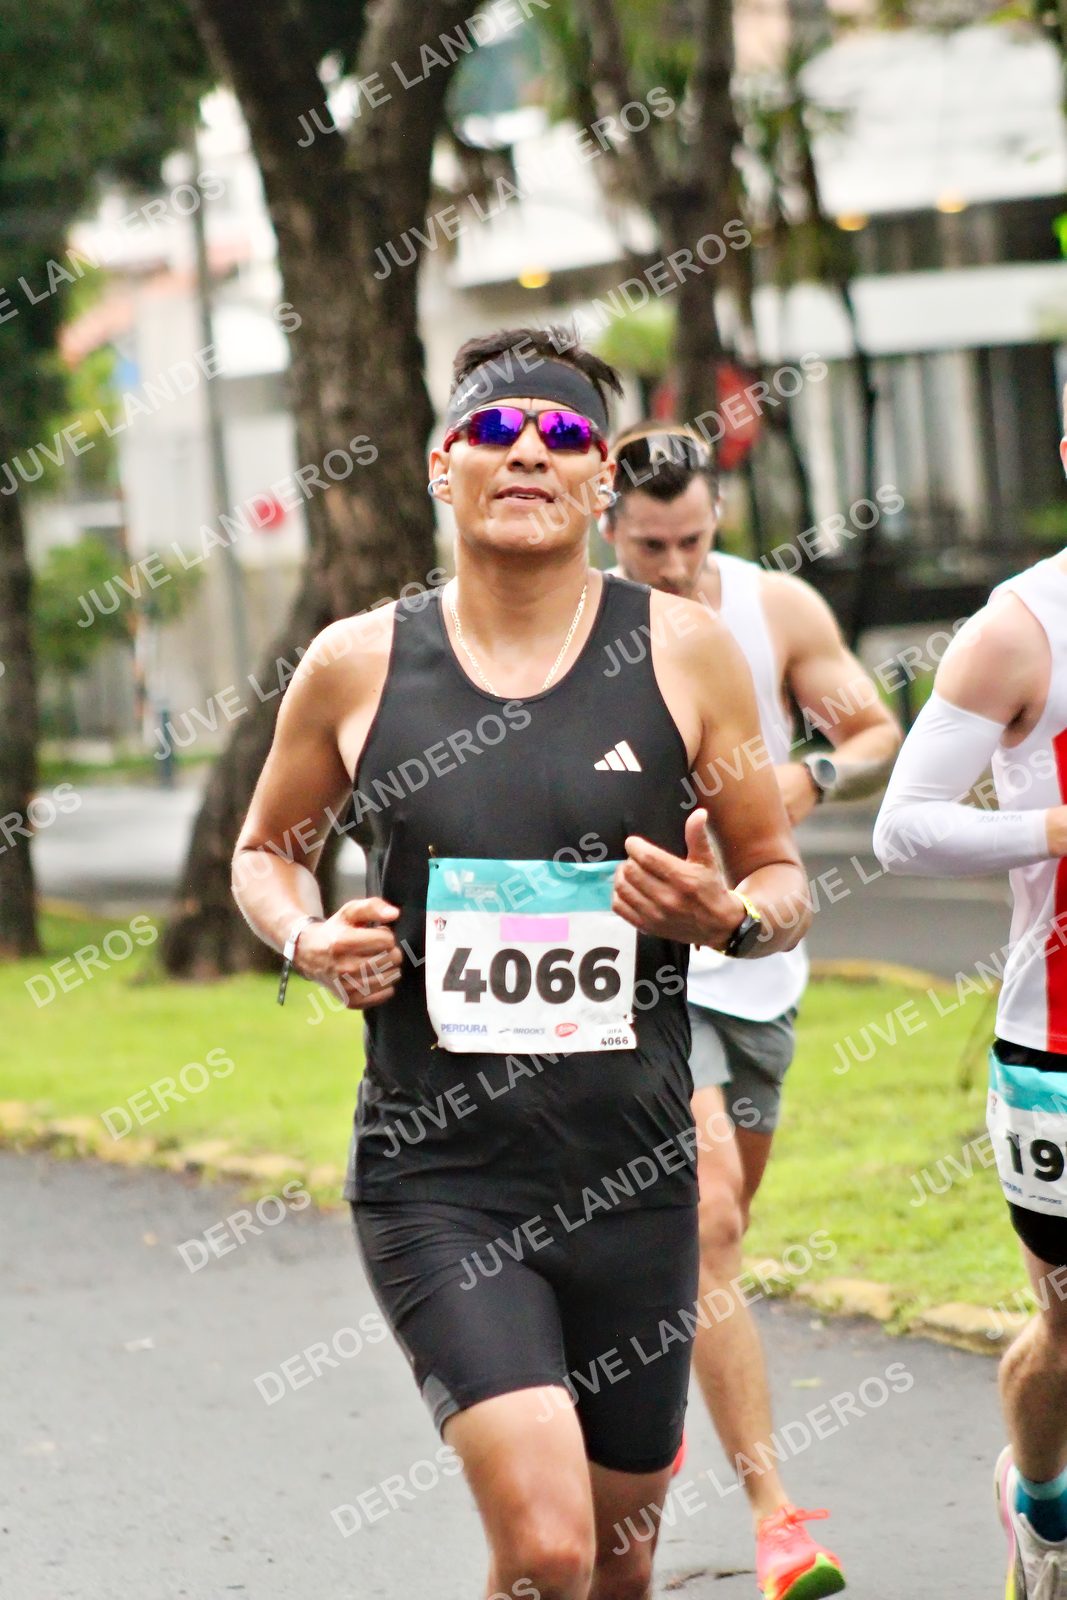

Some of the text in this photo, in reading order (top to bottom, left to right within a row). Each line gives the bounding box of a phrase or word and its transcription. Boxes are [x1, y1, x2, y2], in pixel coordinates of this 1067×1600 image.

[442, 946, 621, 1004] 4066
[440, 1023, 488, 1033] PERDURA
[600, 1036, 629, 1046] 4066
[1005, 1129, 1067, 1183] 19
